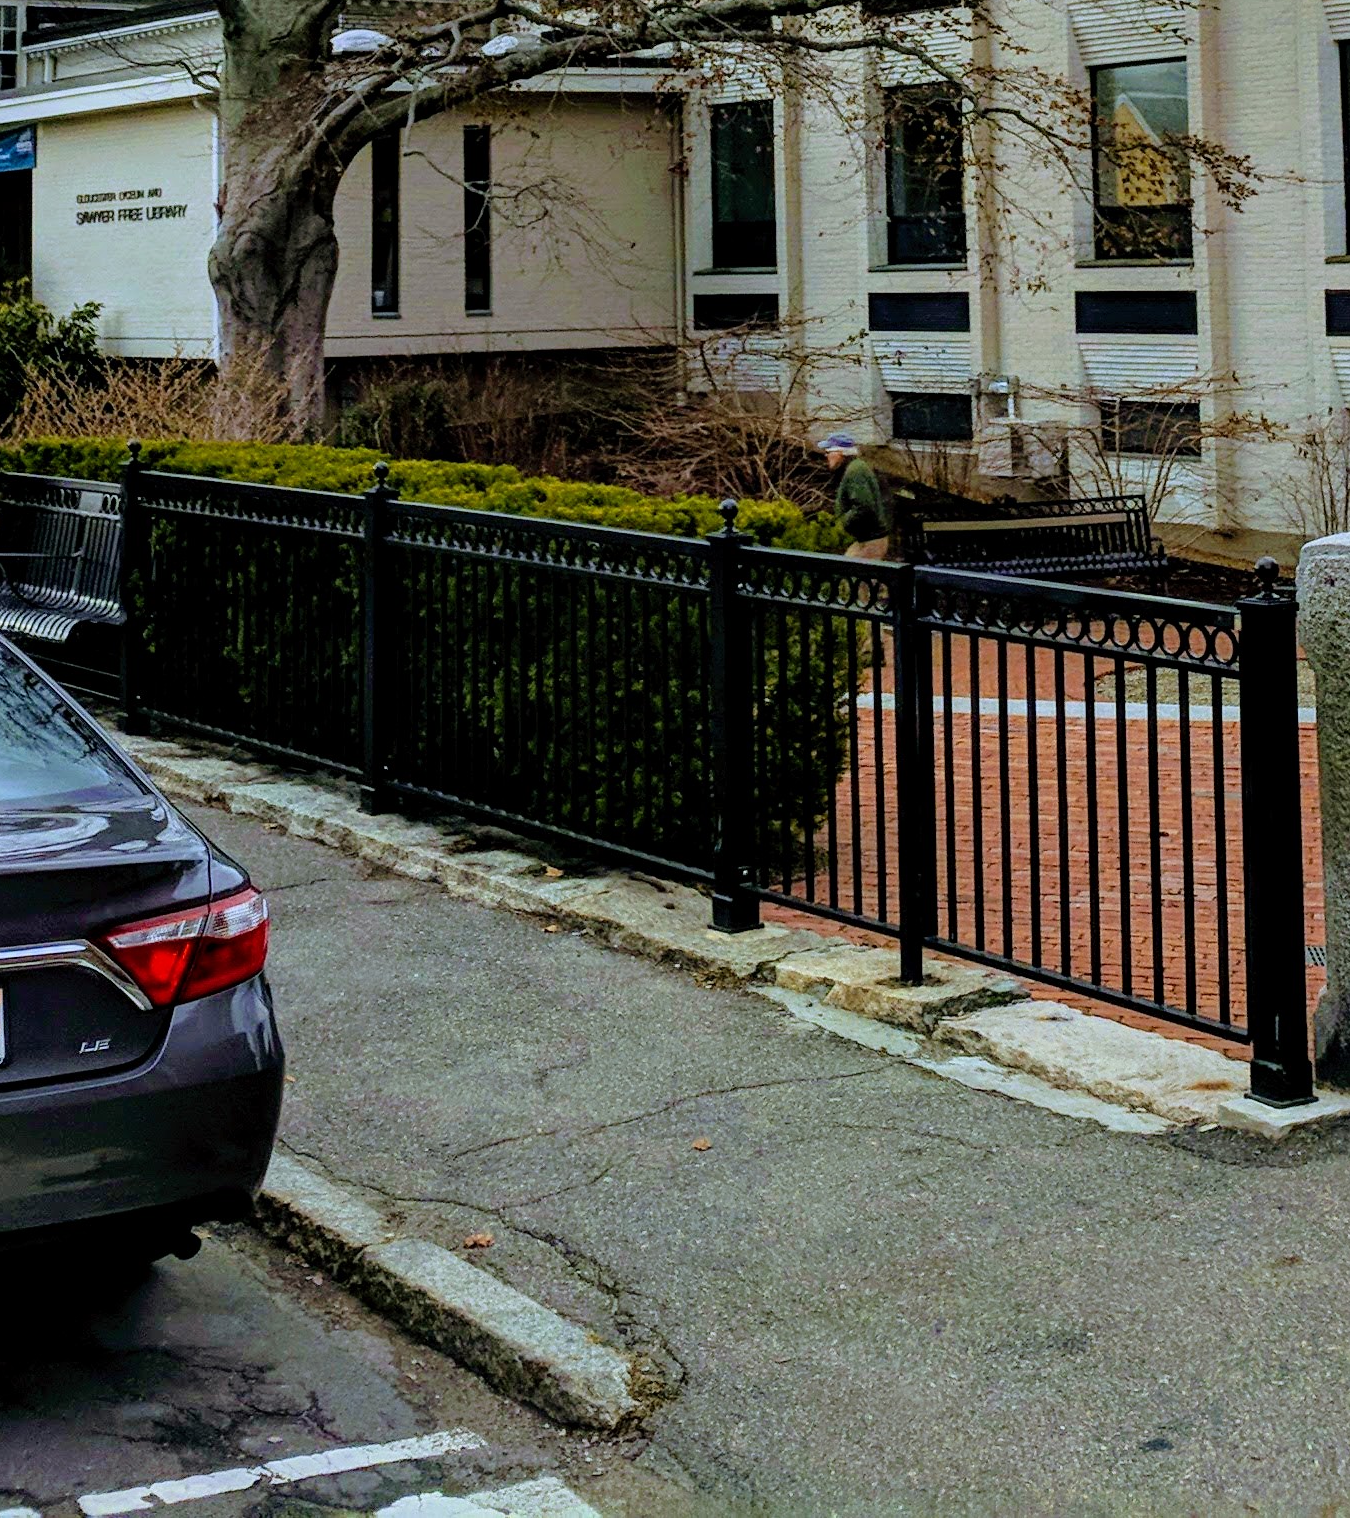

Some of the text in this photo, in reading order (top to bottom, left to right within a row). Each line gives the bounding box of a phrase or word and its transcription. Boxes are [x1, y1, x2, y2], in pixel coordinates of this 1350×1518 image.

[76, 204, 188, 225] SAWYER FREE LIBRARY
[79, 1038, 111, 1054] LE
